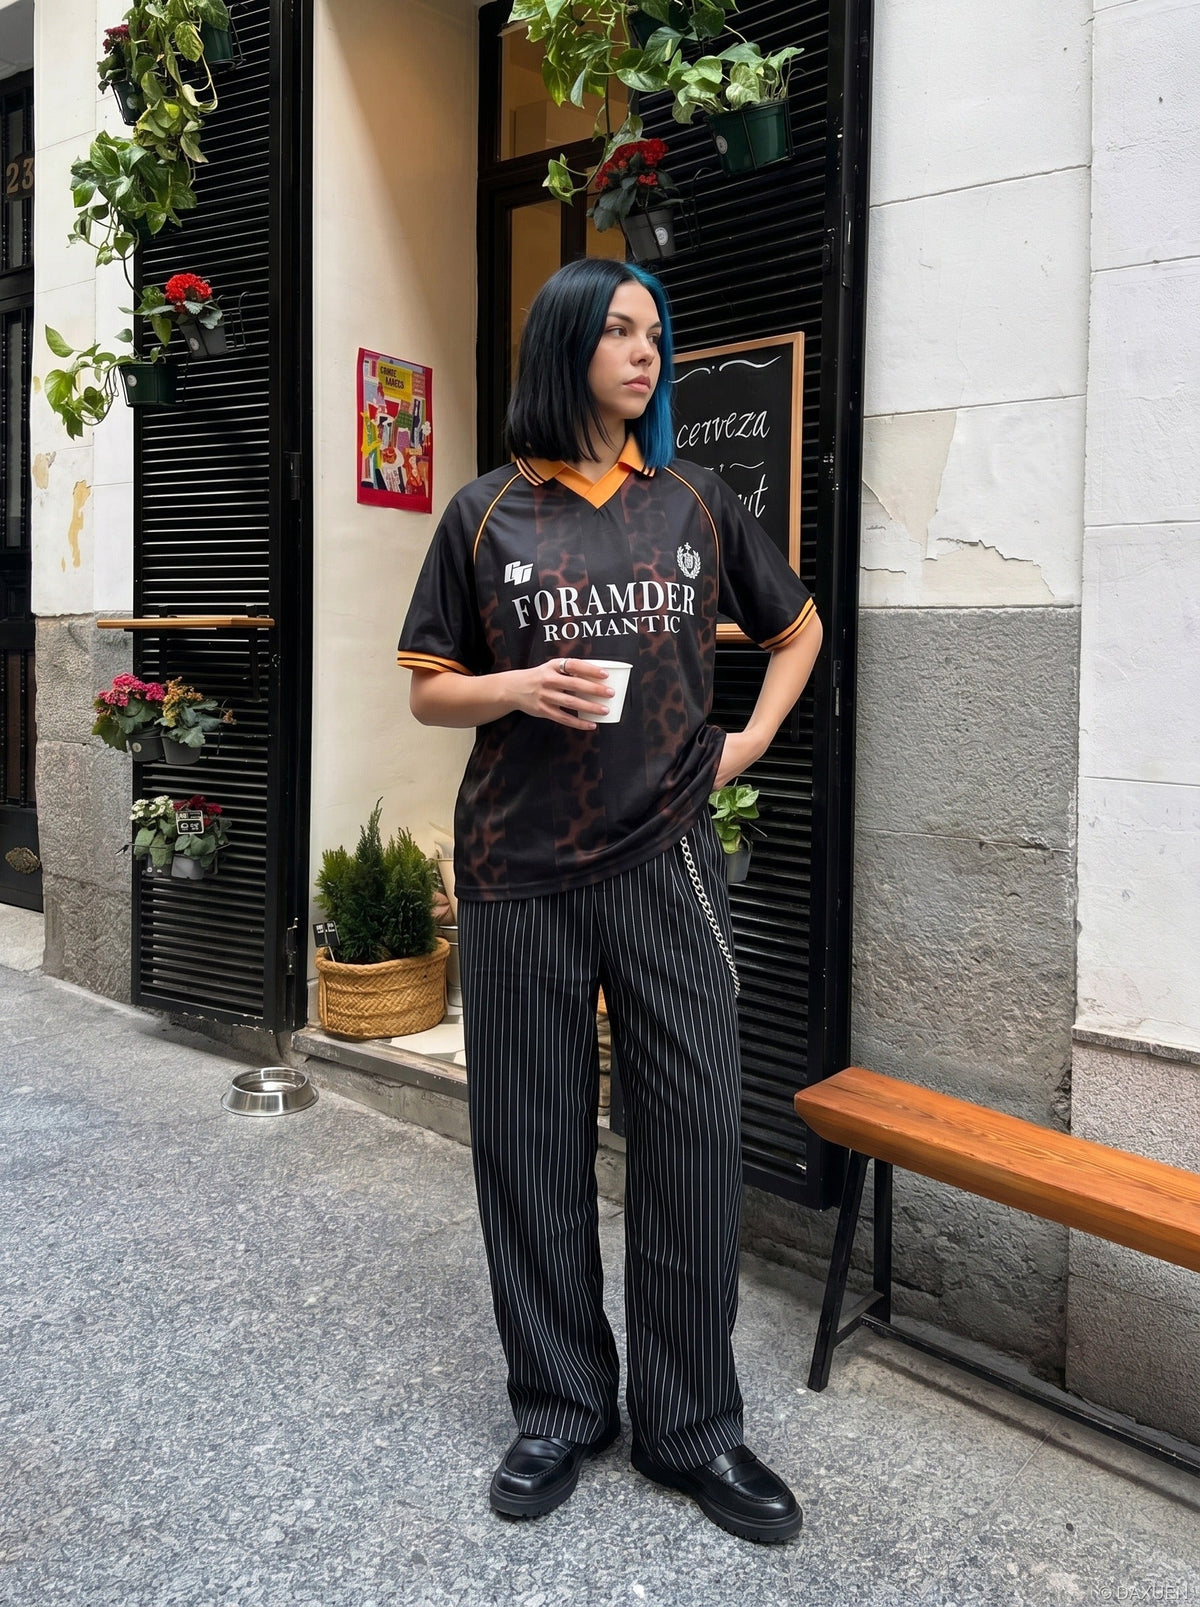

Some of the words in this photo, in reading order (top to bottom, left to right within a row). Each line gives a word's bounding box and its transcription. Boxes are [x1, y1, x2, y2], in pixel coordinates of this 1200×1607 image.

[6, 157, 34, 194] 23
[676, 410, 771, 449] cerveza
[511, 580, 695, 629] FORAMDER
[543, 614, 681, 643] ROMANTIC
